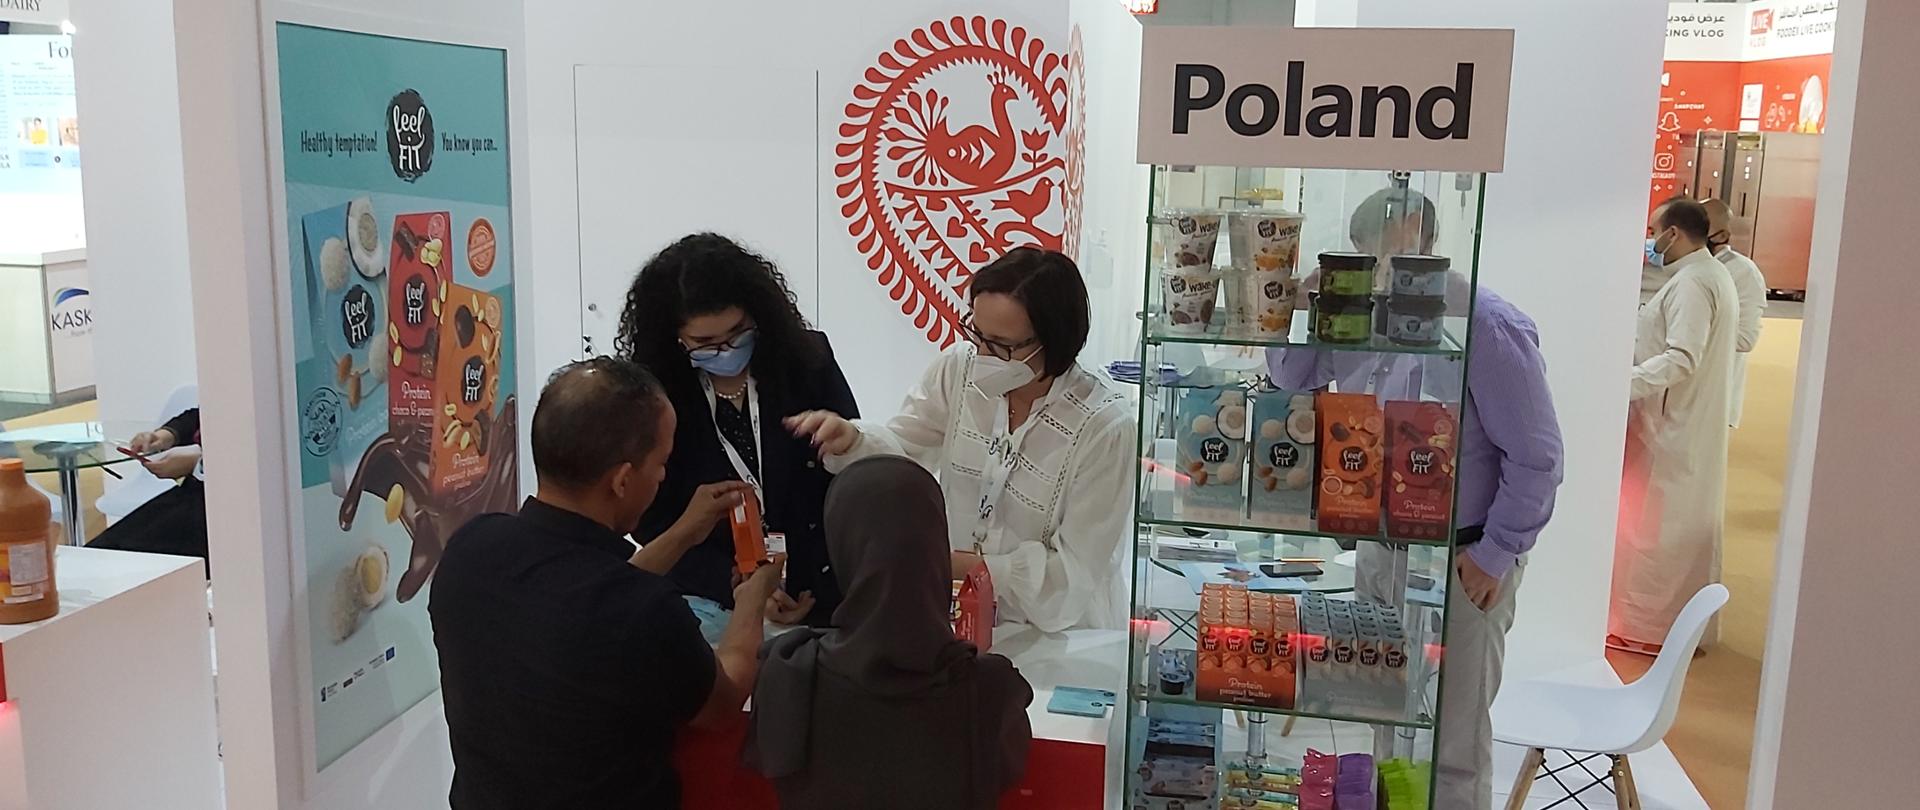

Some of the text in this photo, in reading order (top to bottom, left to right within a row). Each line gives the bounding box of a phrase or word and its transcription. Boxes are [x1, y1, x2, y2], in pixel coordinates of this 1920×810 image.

[1665, 29, 1724, 37] ING VLOG
[1171, 60, 1475, 140] Poland
[393, 104, 426, 144] feel
[301, 131, 377, 158] Healthy temptation!
[441, 134, 453, 151] You
[453, 134, 471, 151] know
[471, 138, 483, 156] you
[399, 143, 422, 171] FIT
[51, 309, 93, 331] KASK
[407, 306, 422, 324] FIT
[351, 321, 368, 344] FIT
[401, 380, 432, 400] Protein
[465, 385, 479, 401] FIT
[1206, 452, 1221, 462] FIT
[1275, 456, 1290, 466] FIT
[1344, 461, 1360, 471] FIT
[1412, 464, 1430, 474] FIT
